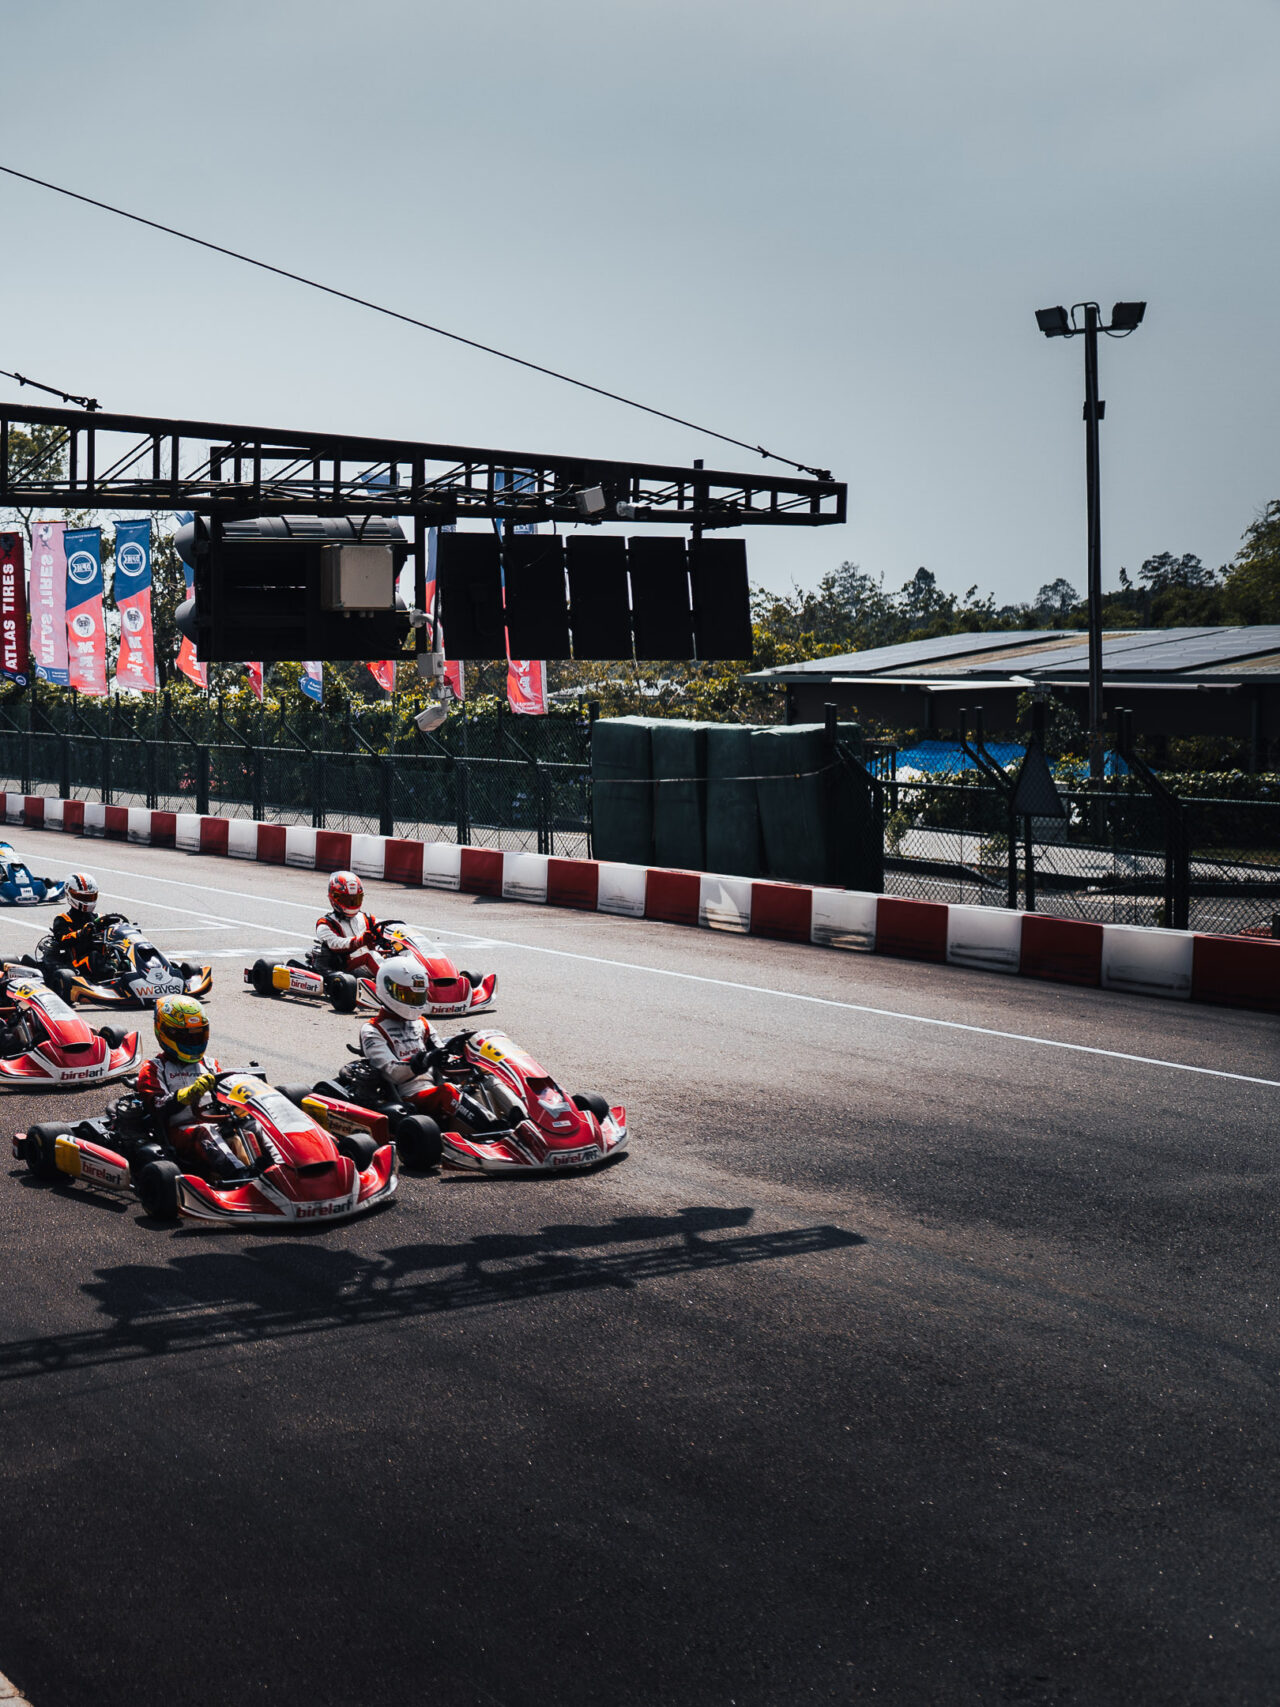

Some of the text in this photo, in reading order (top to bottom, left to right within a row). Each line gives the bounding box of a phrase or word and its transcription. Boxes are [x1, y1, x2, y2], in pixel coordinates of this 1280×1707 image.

[2, 563, 15, 614] TIRES
[3, 619, 18, 670] ATLAS
[290, 978, 318, 992] birelart
[431, 1003, 467, 1014] birelart
[60, 1066, 105, 1081] birelart
[82, 1161, 121, 1185] birelart
[296, 1199, 353, 1218] birelart
